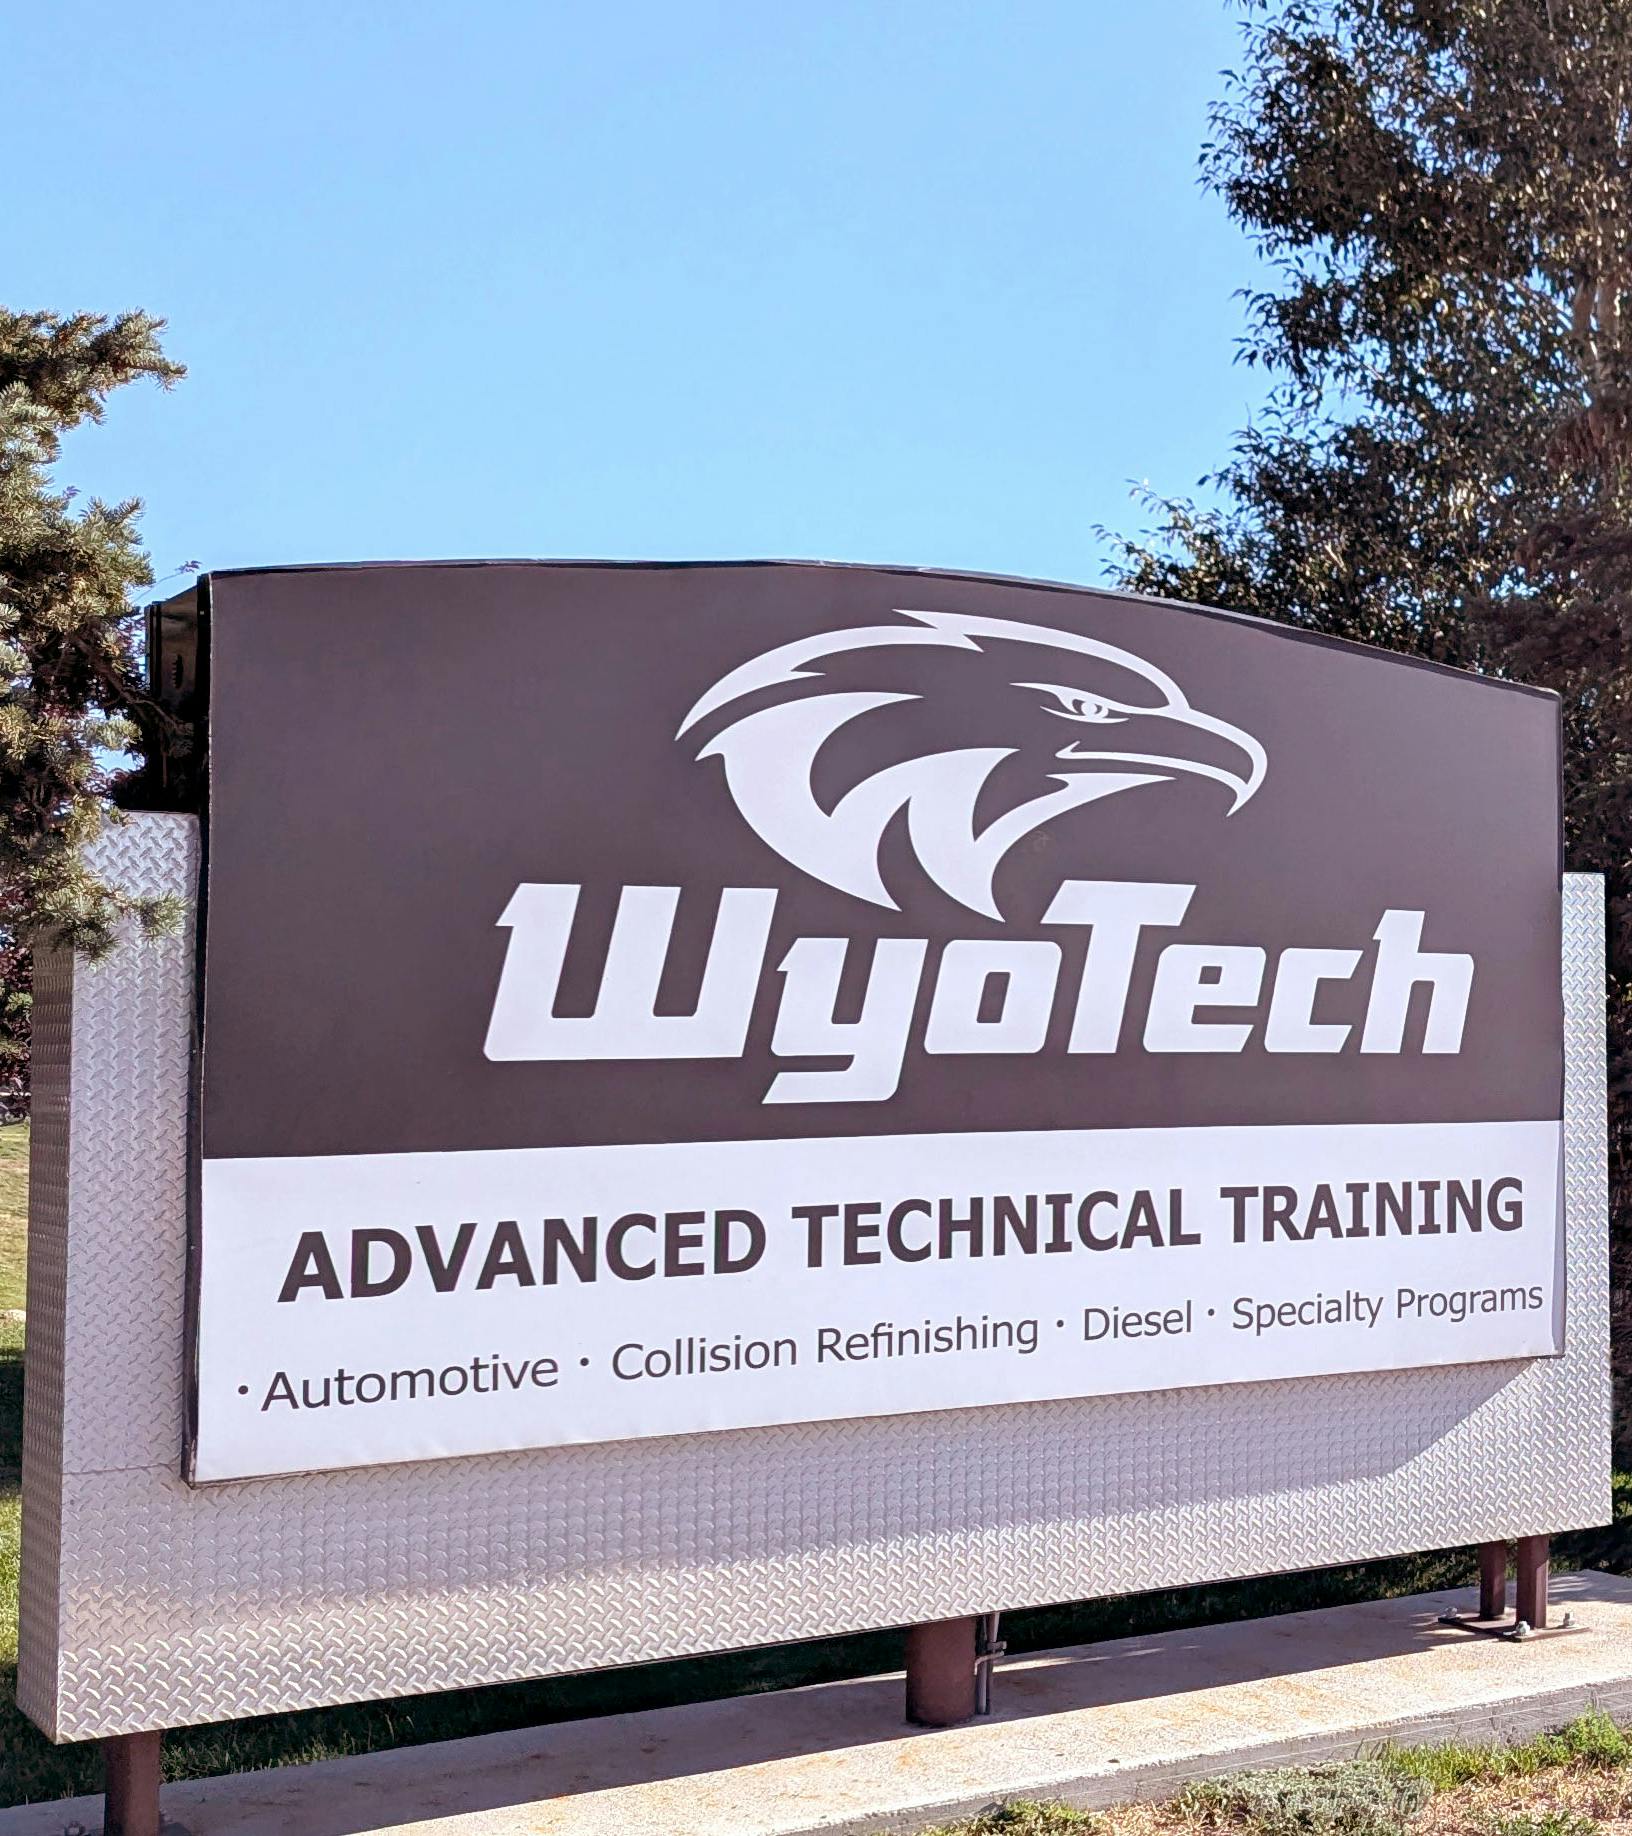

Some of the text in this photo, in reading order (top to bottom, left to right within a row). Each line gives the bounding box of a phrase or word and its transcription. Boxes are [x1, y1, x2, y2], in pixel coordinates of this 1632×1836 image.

[484, 880, 1475, 1105] WyoTech
[278, 1176, 1523, 1303] ADVANCED TECHNICAL TRAINING
[261, 1286, 1543, 1412] Automotive Collision Refinishing Diesel Specialty Programs
